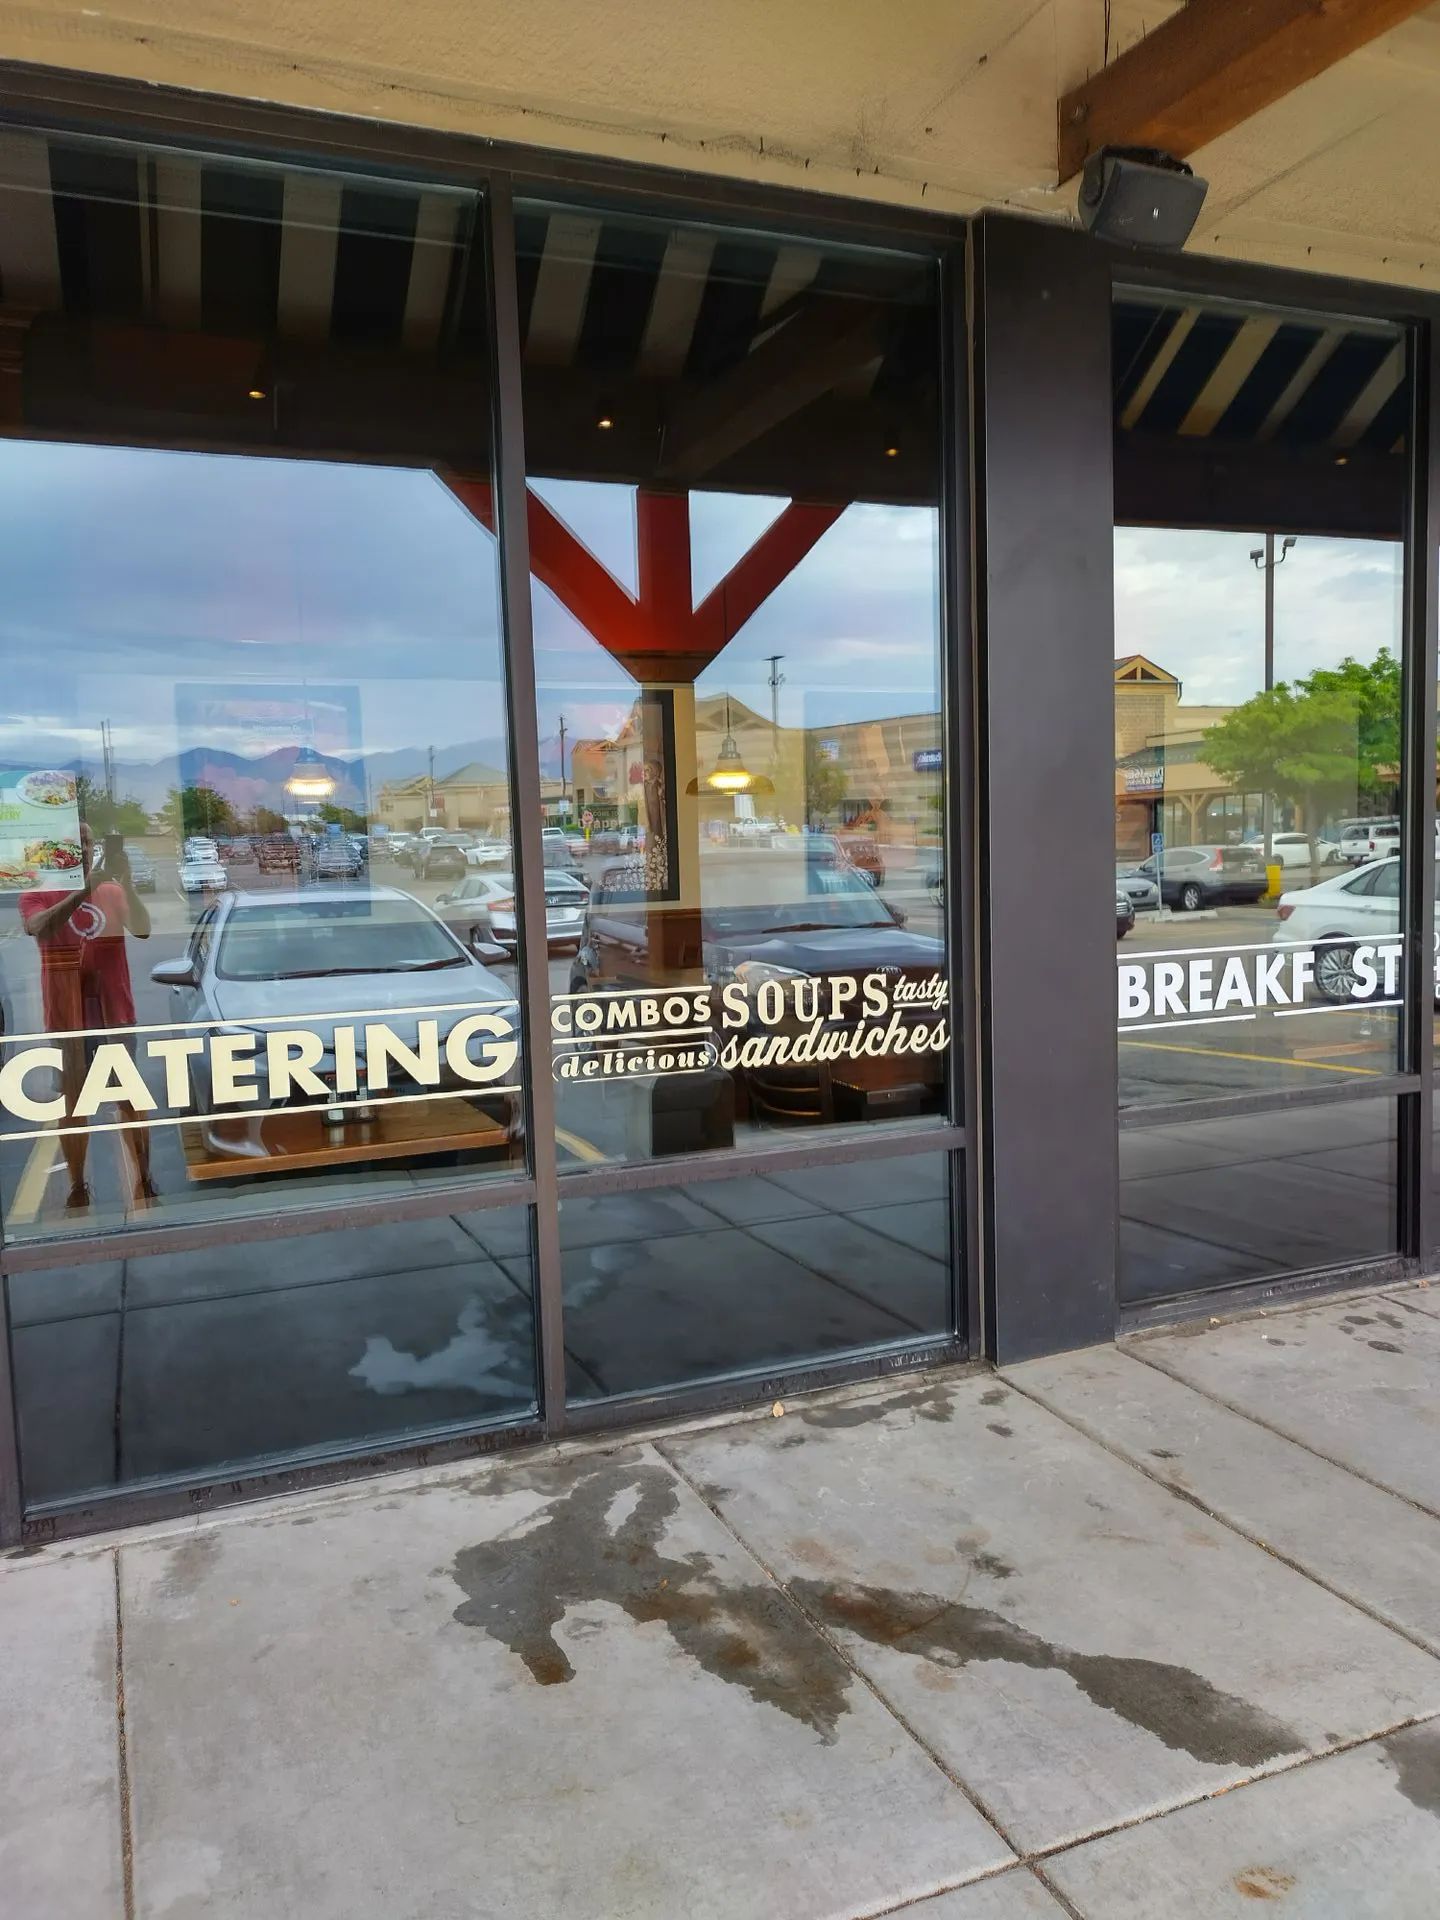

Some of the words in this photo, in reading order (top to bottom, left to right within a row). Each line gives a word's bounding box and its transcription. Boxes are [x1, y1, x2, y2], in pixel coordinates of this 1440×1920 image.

[551, 995, 711, 1032] COMBOS
[722, 973, 888, 1028] SOUPS
[893, 972, 948, 1010] tasty
[560, 1049, 711, 1078] delicious
[720, 1011, 951, 1071] sandwiches
[0, 1015, 519, 1121] CATERING
